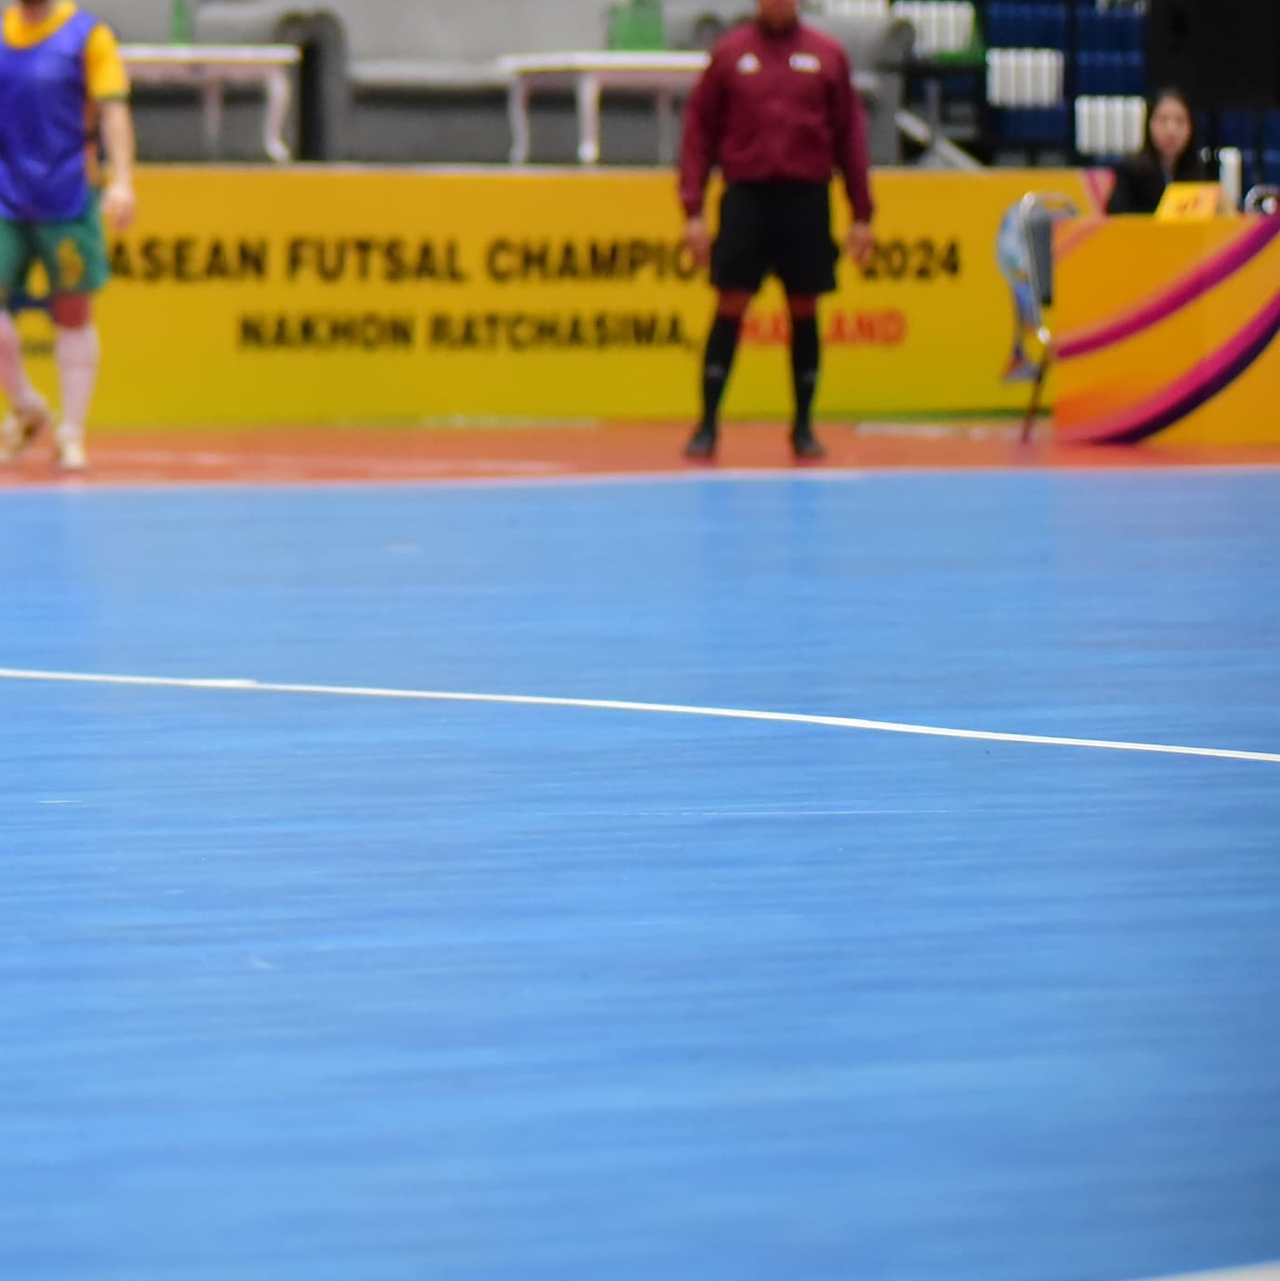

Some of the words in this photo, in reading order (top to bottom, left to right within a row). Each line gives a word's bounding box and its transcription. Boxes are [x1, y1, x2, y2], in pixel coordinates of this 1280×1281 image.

[109, 237, 268, 282] ASEAN
[286, 237, 468, 282] FUTSAL
[239, 314, 415, 351] NAKHON
